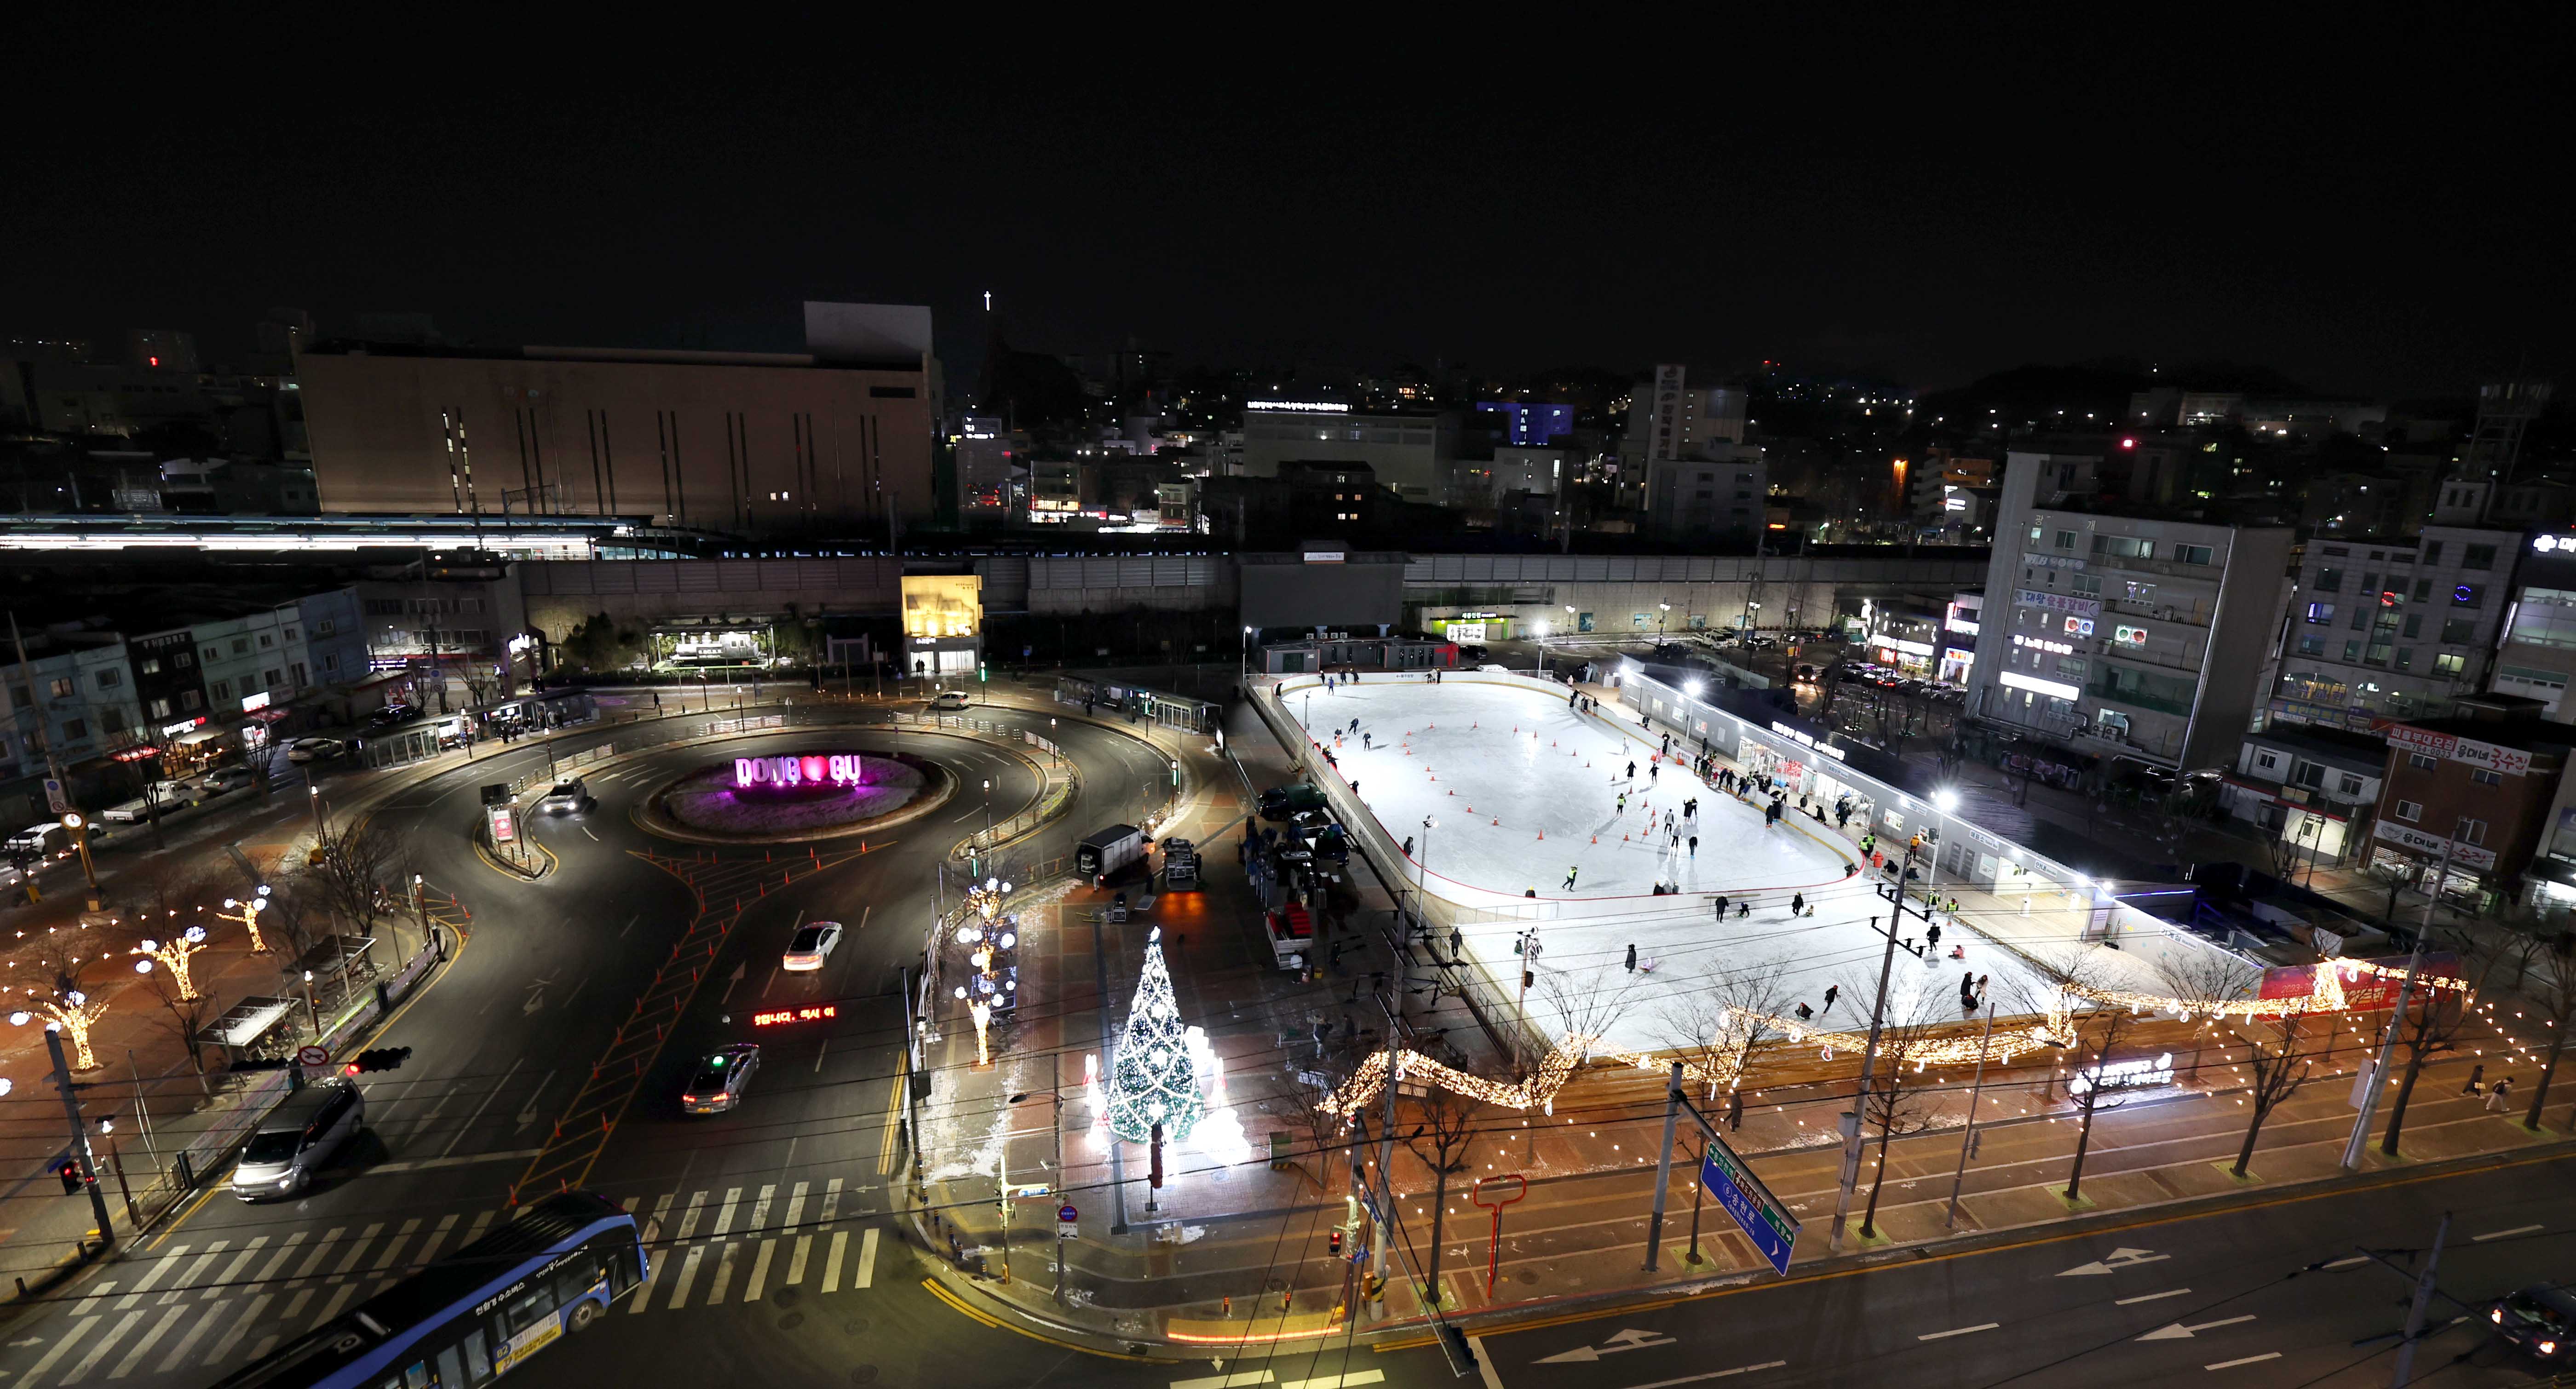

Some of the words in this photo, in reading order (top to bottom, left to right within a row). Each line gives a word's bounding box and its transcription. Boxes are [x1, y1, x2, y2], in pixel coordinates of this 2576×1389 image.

[2412, 744, 2451, 759] 764-0033
[736, 756, 801, 784] DONG
[829, 754, 862, 781] GU
[2036, 861, 2047, 872] 안내
[800, 1008, 820, 1019] 즉시
[1714, 1152, 1734, 1178] 동인천역
[1732, 1193, 1755, 1225] 송현로
